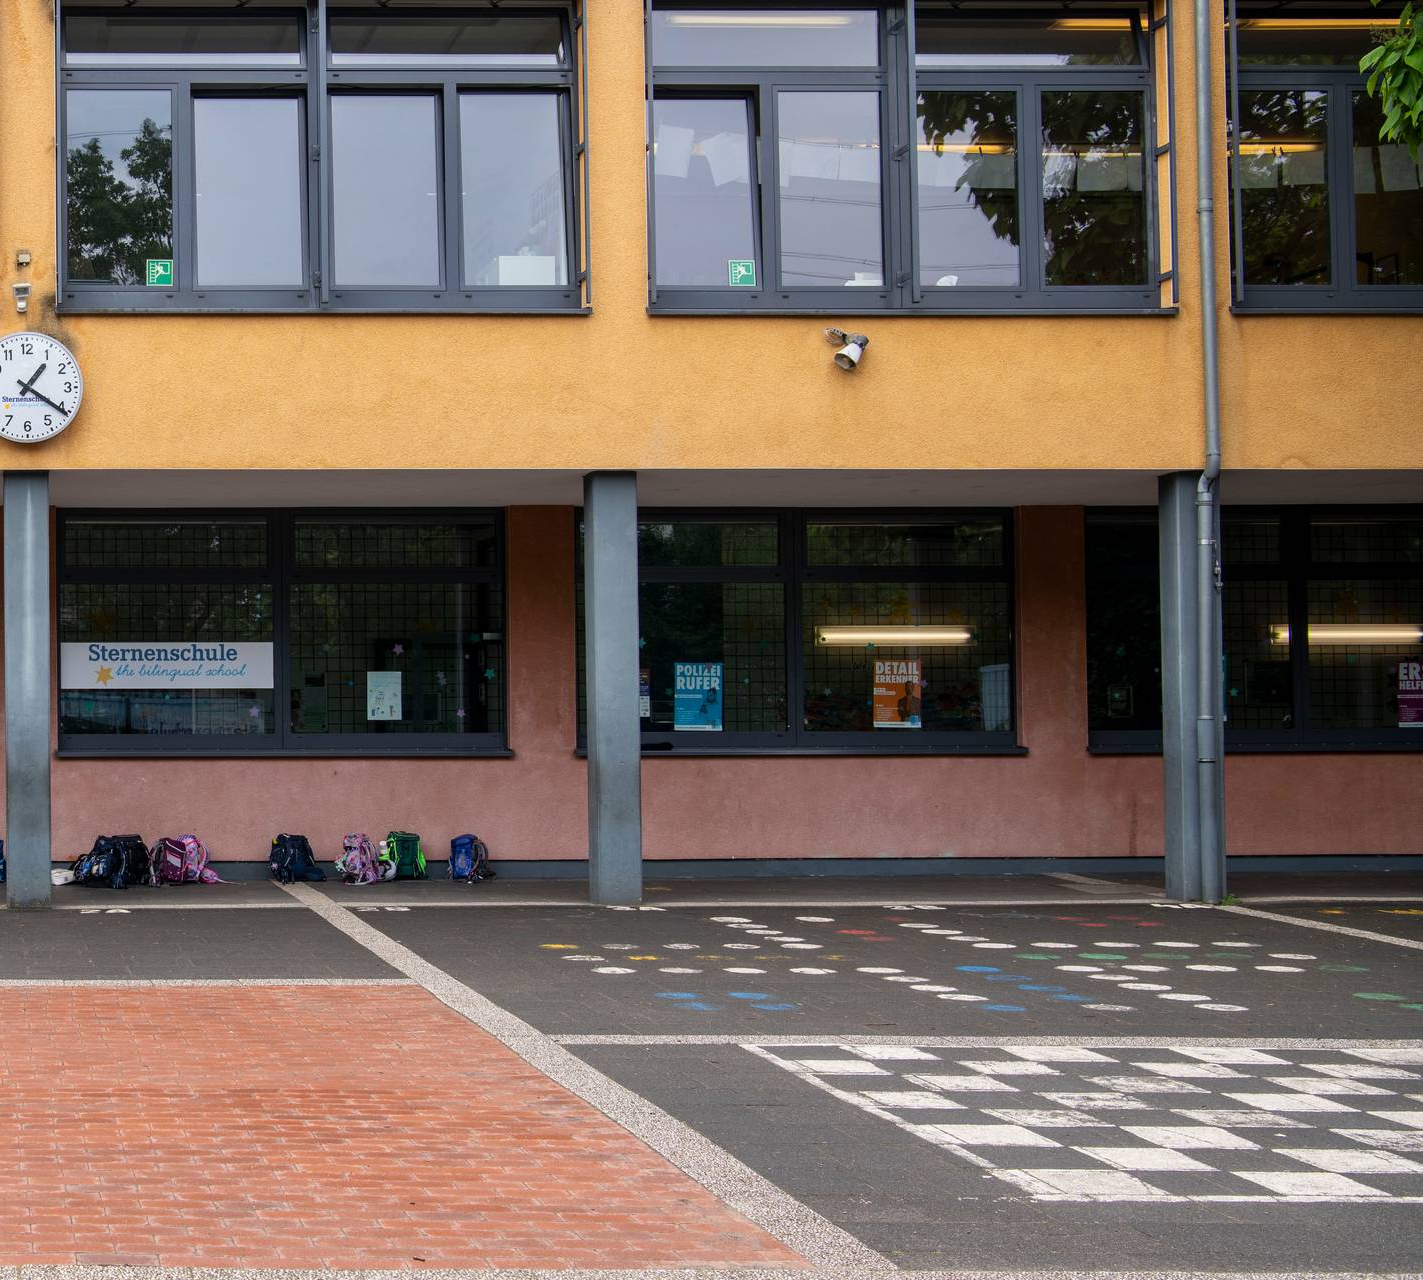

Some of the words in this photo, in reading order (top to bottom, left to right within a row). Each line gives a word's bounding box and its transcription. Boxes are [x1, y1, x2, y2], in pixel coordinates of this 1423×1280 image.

[3, 349, 13, 360] 11
[21, 344, 33, 355] 12
[44, 349, 49, 360] 1
[58, 363, 66, 374] 2
[64, 382, 72, 393] 3
[5, 415, 13, 426] 7
[44, 415, 52, 426] 5
[23, 421, 32, 432] 6
[88, 643, 238, 662] Sternenschule
[115, 664, 135, 676] the
[138, 664, 202, 682] bilingual
[206, 664, 247, 676] school
[676, 664, 721, 676] POLIZEI
[875, 662, 919, 674] DETAIL
[1399, 662, 1423, 680] ER
[676, 676, 720, 690] RUFER
[875, 675, 919, 683] ERKENNER
